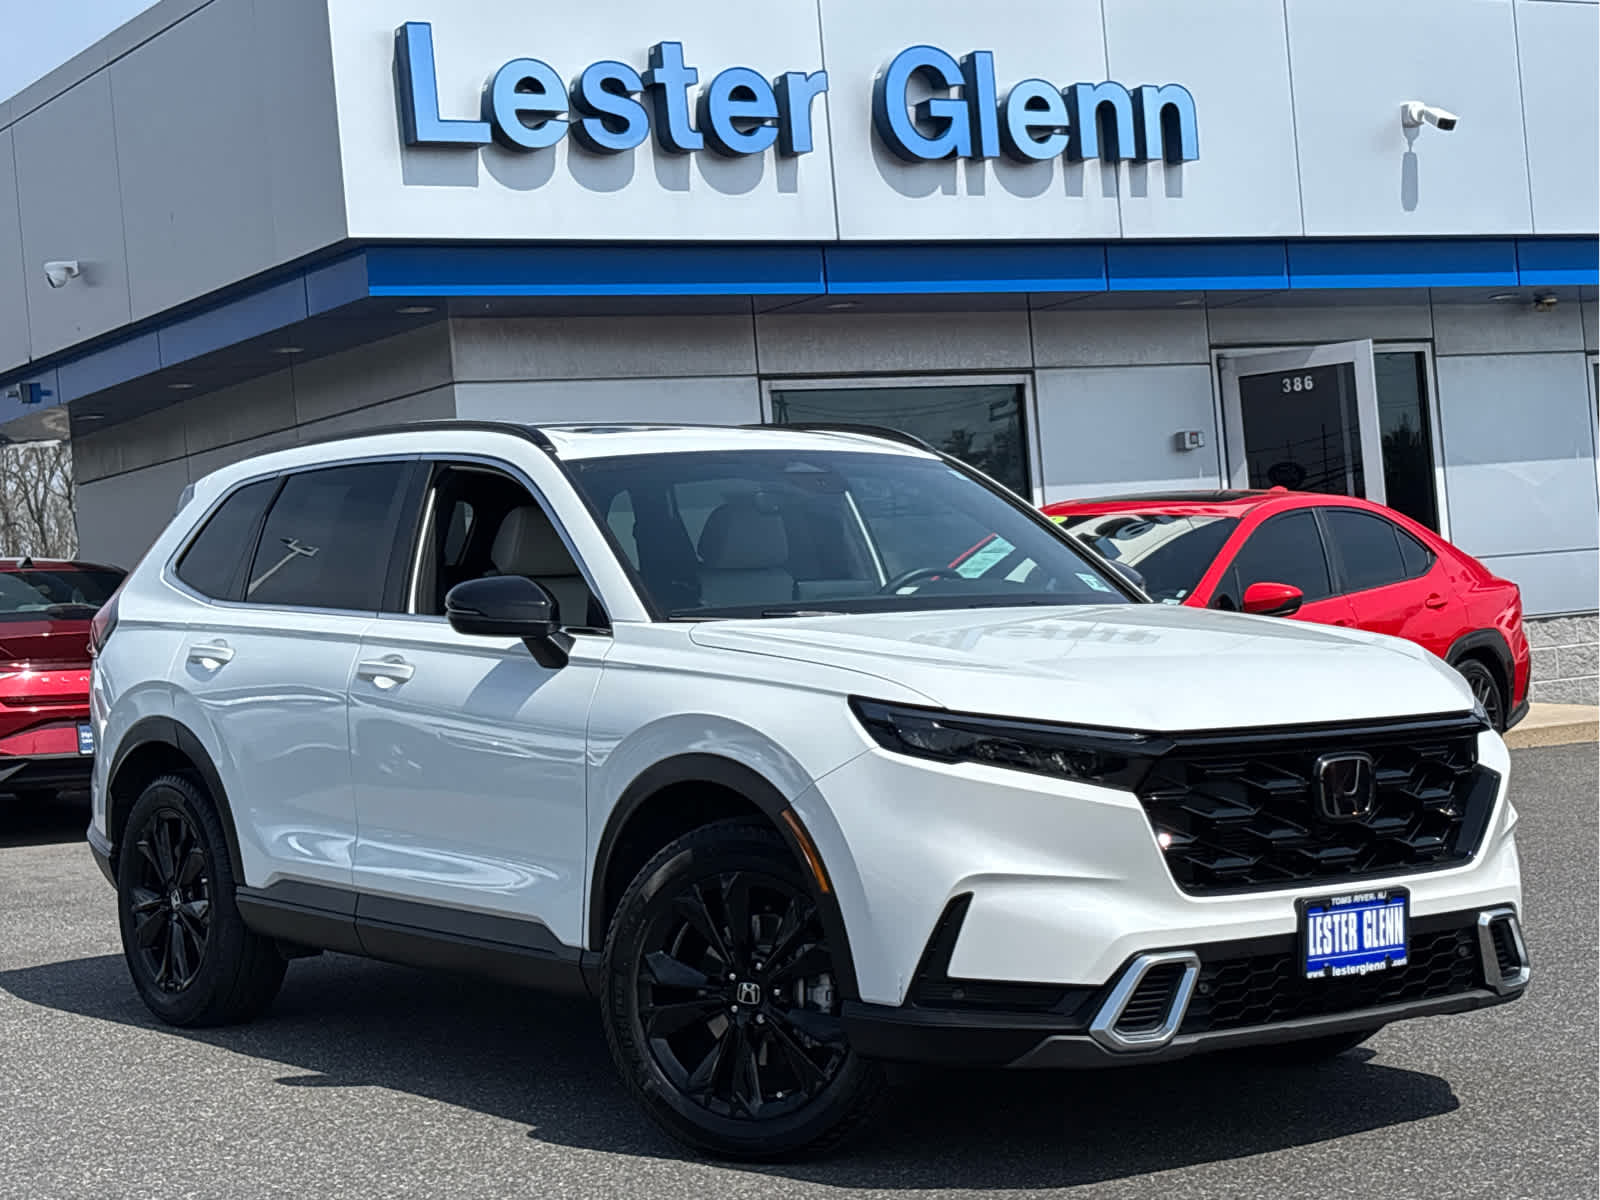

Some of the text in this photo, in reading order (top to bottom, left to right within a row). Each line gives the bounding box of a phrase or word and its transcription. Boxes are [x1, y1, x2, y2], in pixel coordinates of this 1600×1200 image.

[396, 21, 1199, 163] Lester Glenn
[1282, 375, 1313, 393] 386
[1331, 896, 1352, 905] TOMS
[1377, 891, 1387, 899] NJ
[1308, 906, 1404, 956] LESTER GLENN
